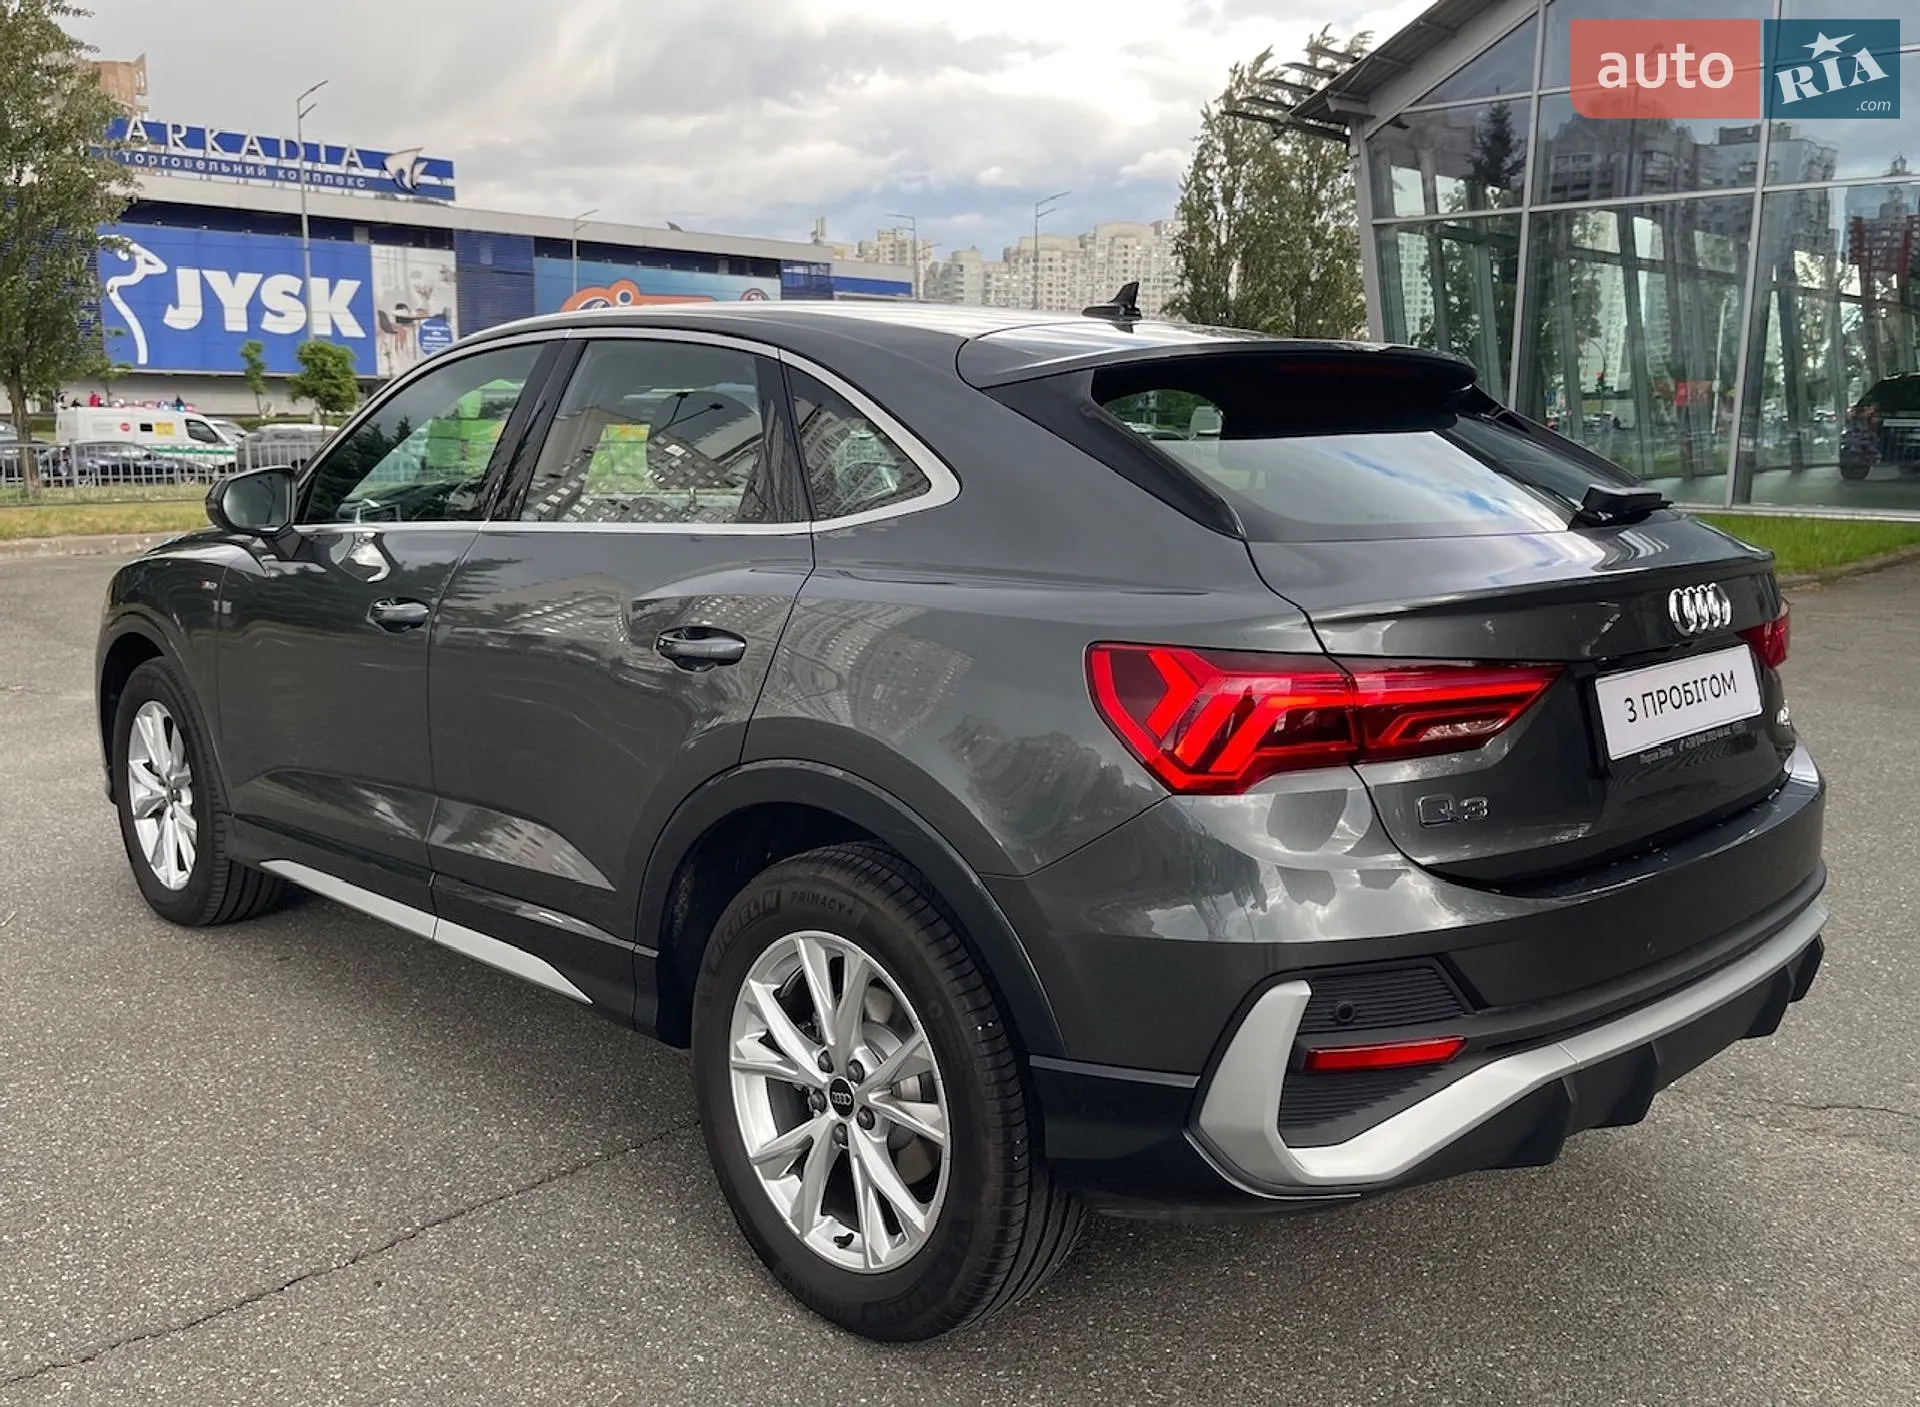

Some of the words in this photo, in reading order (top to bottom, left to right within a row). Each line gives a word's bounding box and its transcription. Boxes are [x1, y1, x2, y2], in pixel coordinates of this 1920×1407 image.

[125, 115, 364, 171] ARKADIA
[123, 151, 268, 178] торговельний
[163, 267, 367, 338] JYSK
[1641, 670, 1738, 718] ПРОБІГОМ
[1415, 794, 1490, 829] Q3
[791, 890, 846, 914] PRIMACY
